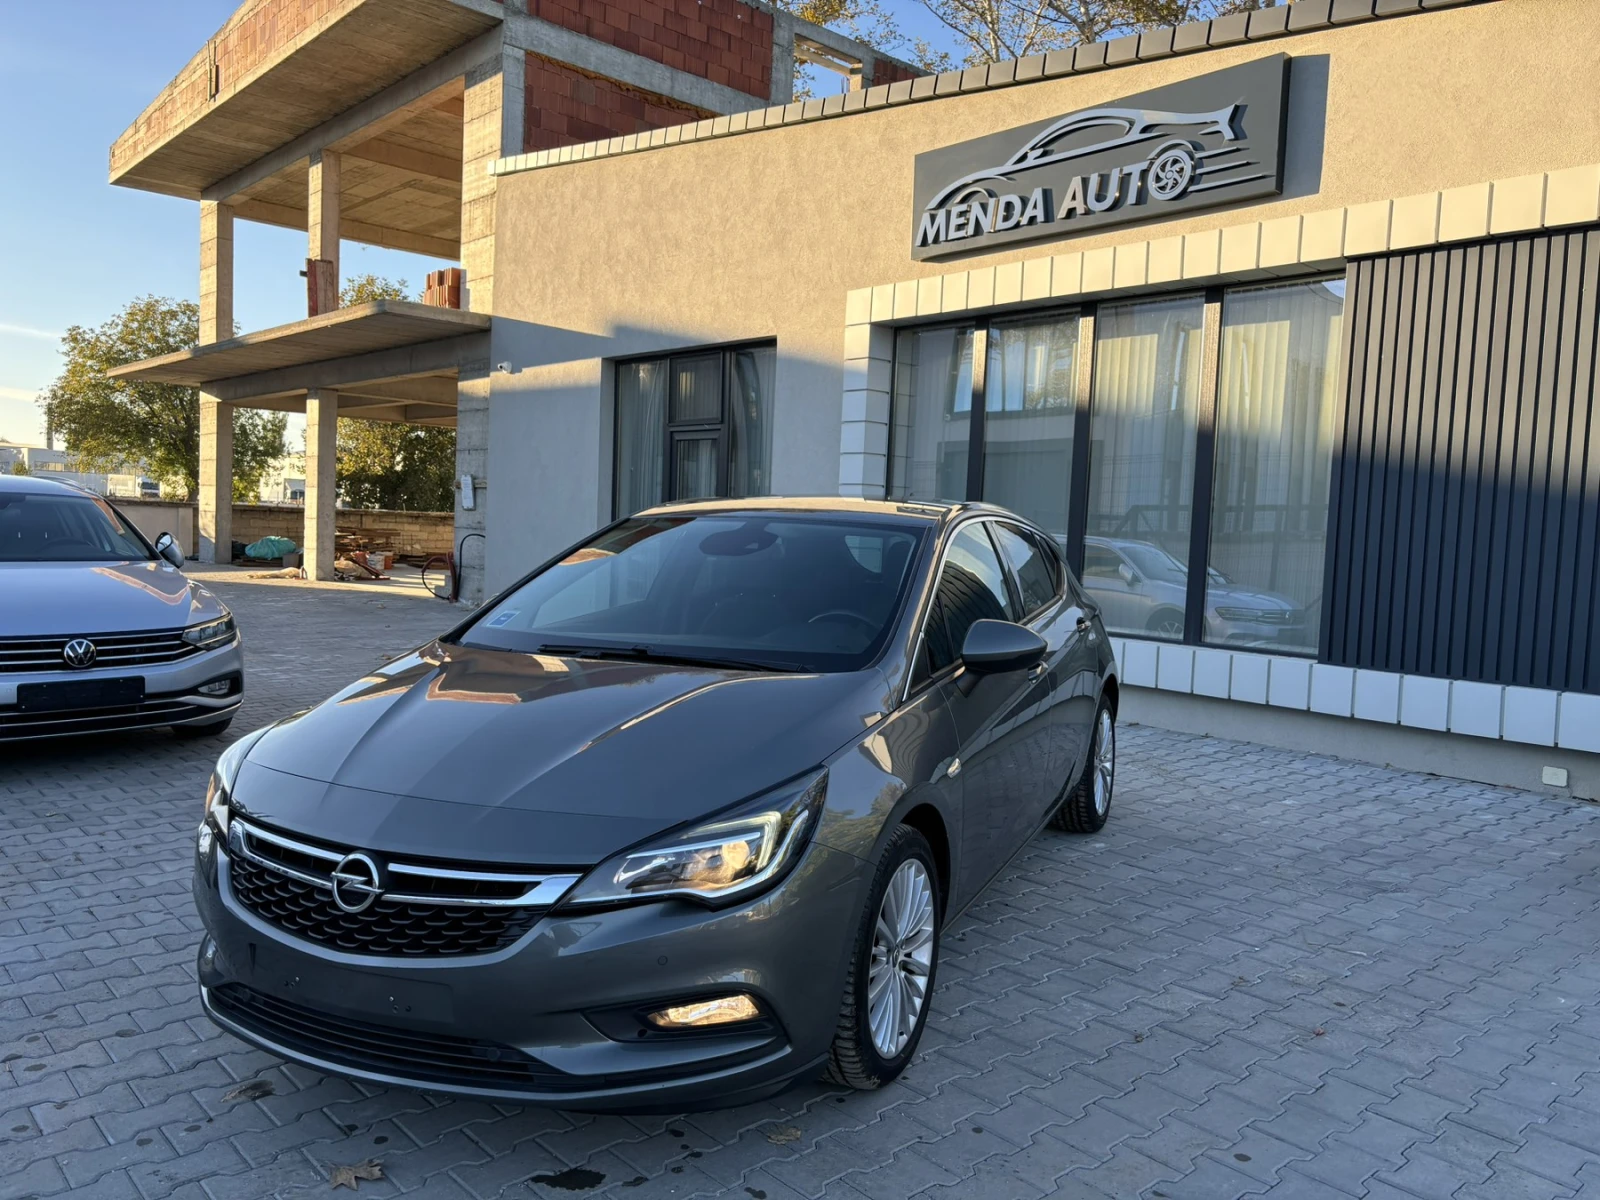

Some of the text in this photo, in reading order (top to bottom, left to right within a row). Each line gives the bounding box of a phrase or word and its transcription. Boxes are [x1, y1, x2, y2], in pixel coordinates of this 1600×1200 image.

[915, 149, 1193, 247] MENDA AUTO
[65, 639, 96, 667] VW
